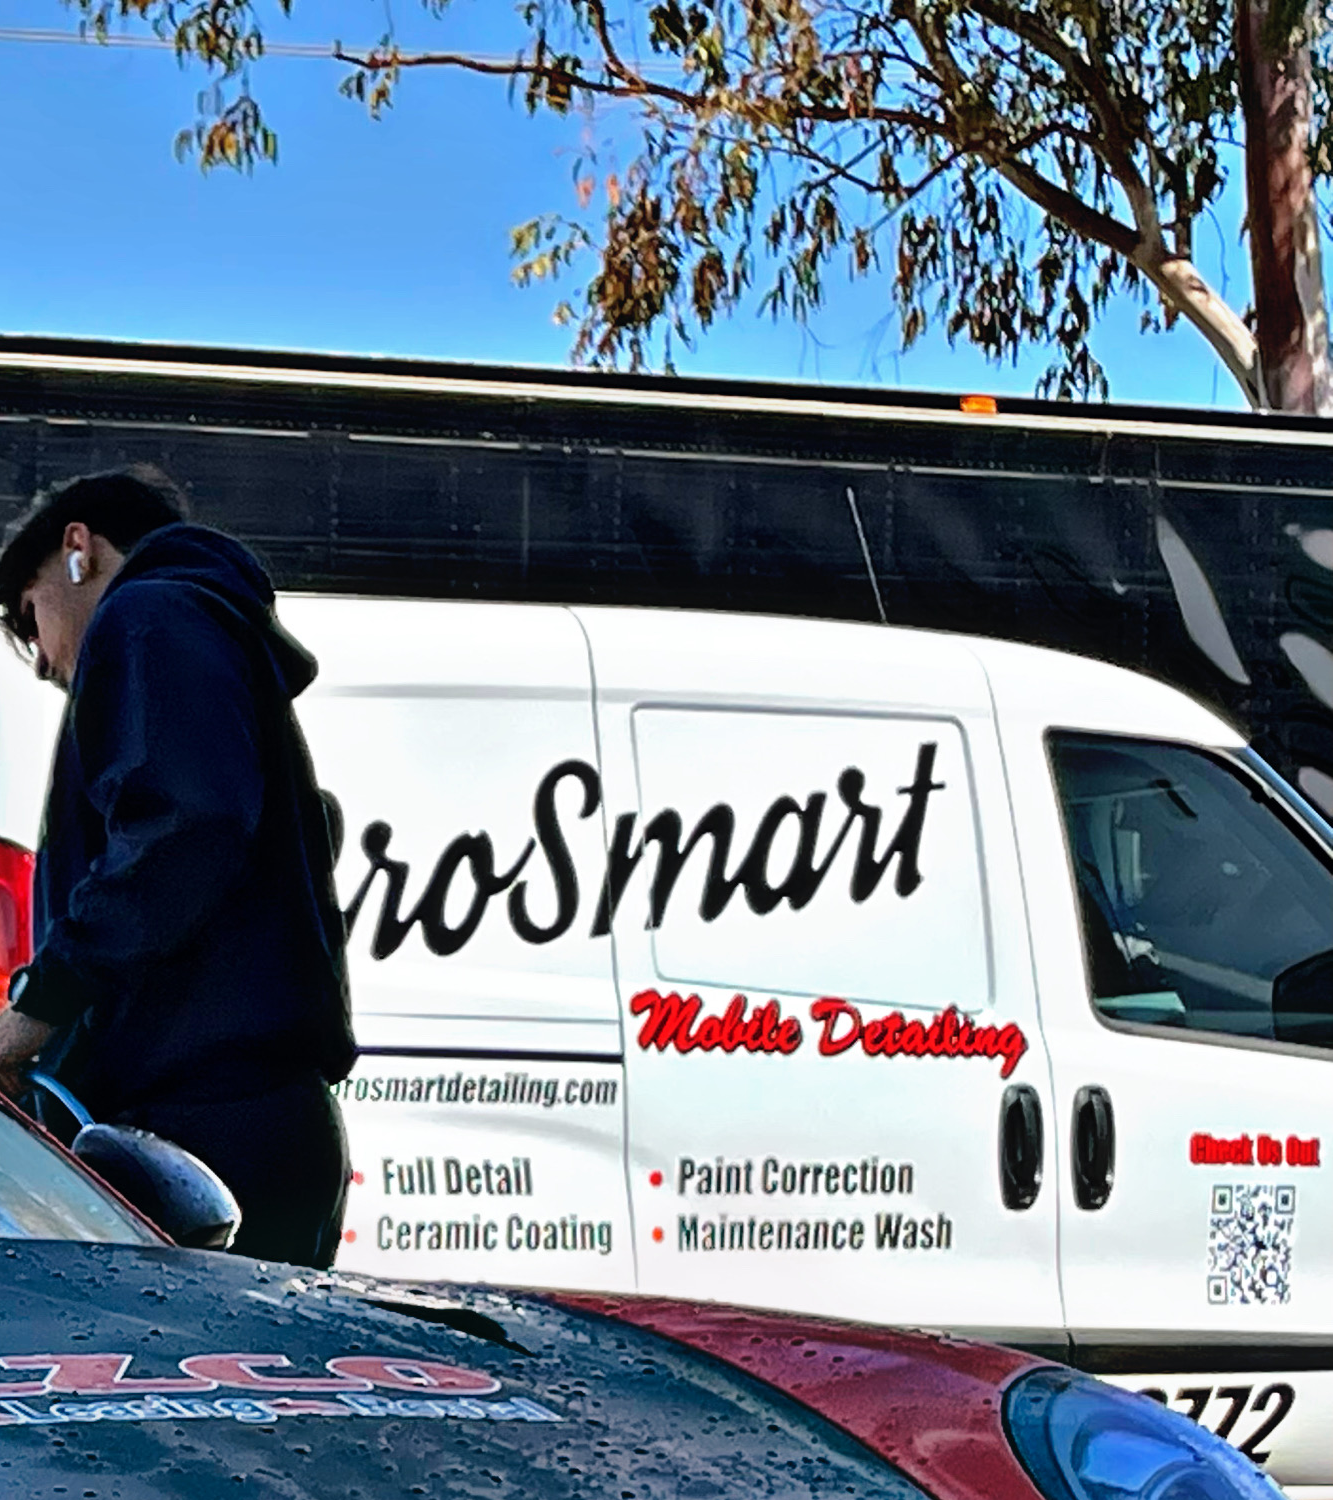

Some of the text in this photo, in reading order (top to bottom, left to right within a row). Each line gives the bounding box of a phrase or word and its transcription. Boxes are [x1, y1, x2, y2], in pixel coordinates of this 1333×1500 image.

[630, 988, 1030, 1080] Mobile Detailing
[1189, 1131, 1321, 1168] Check Us Out
[381, 1156, 533, 1197] Full Detail
[677, 1156, 915, 1195] Paint Correction
[376, 1213, 613, 1256] Ceramic Coating
[677, 1211, 954, 1252] Maintenance Wash
[1137, 1381, 1297, 1465] 772
